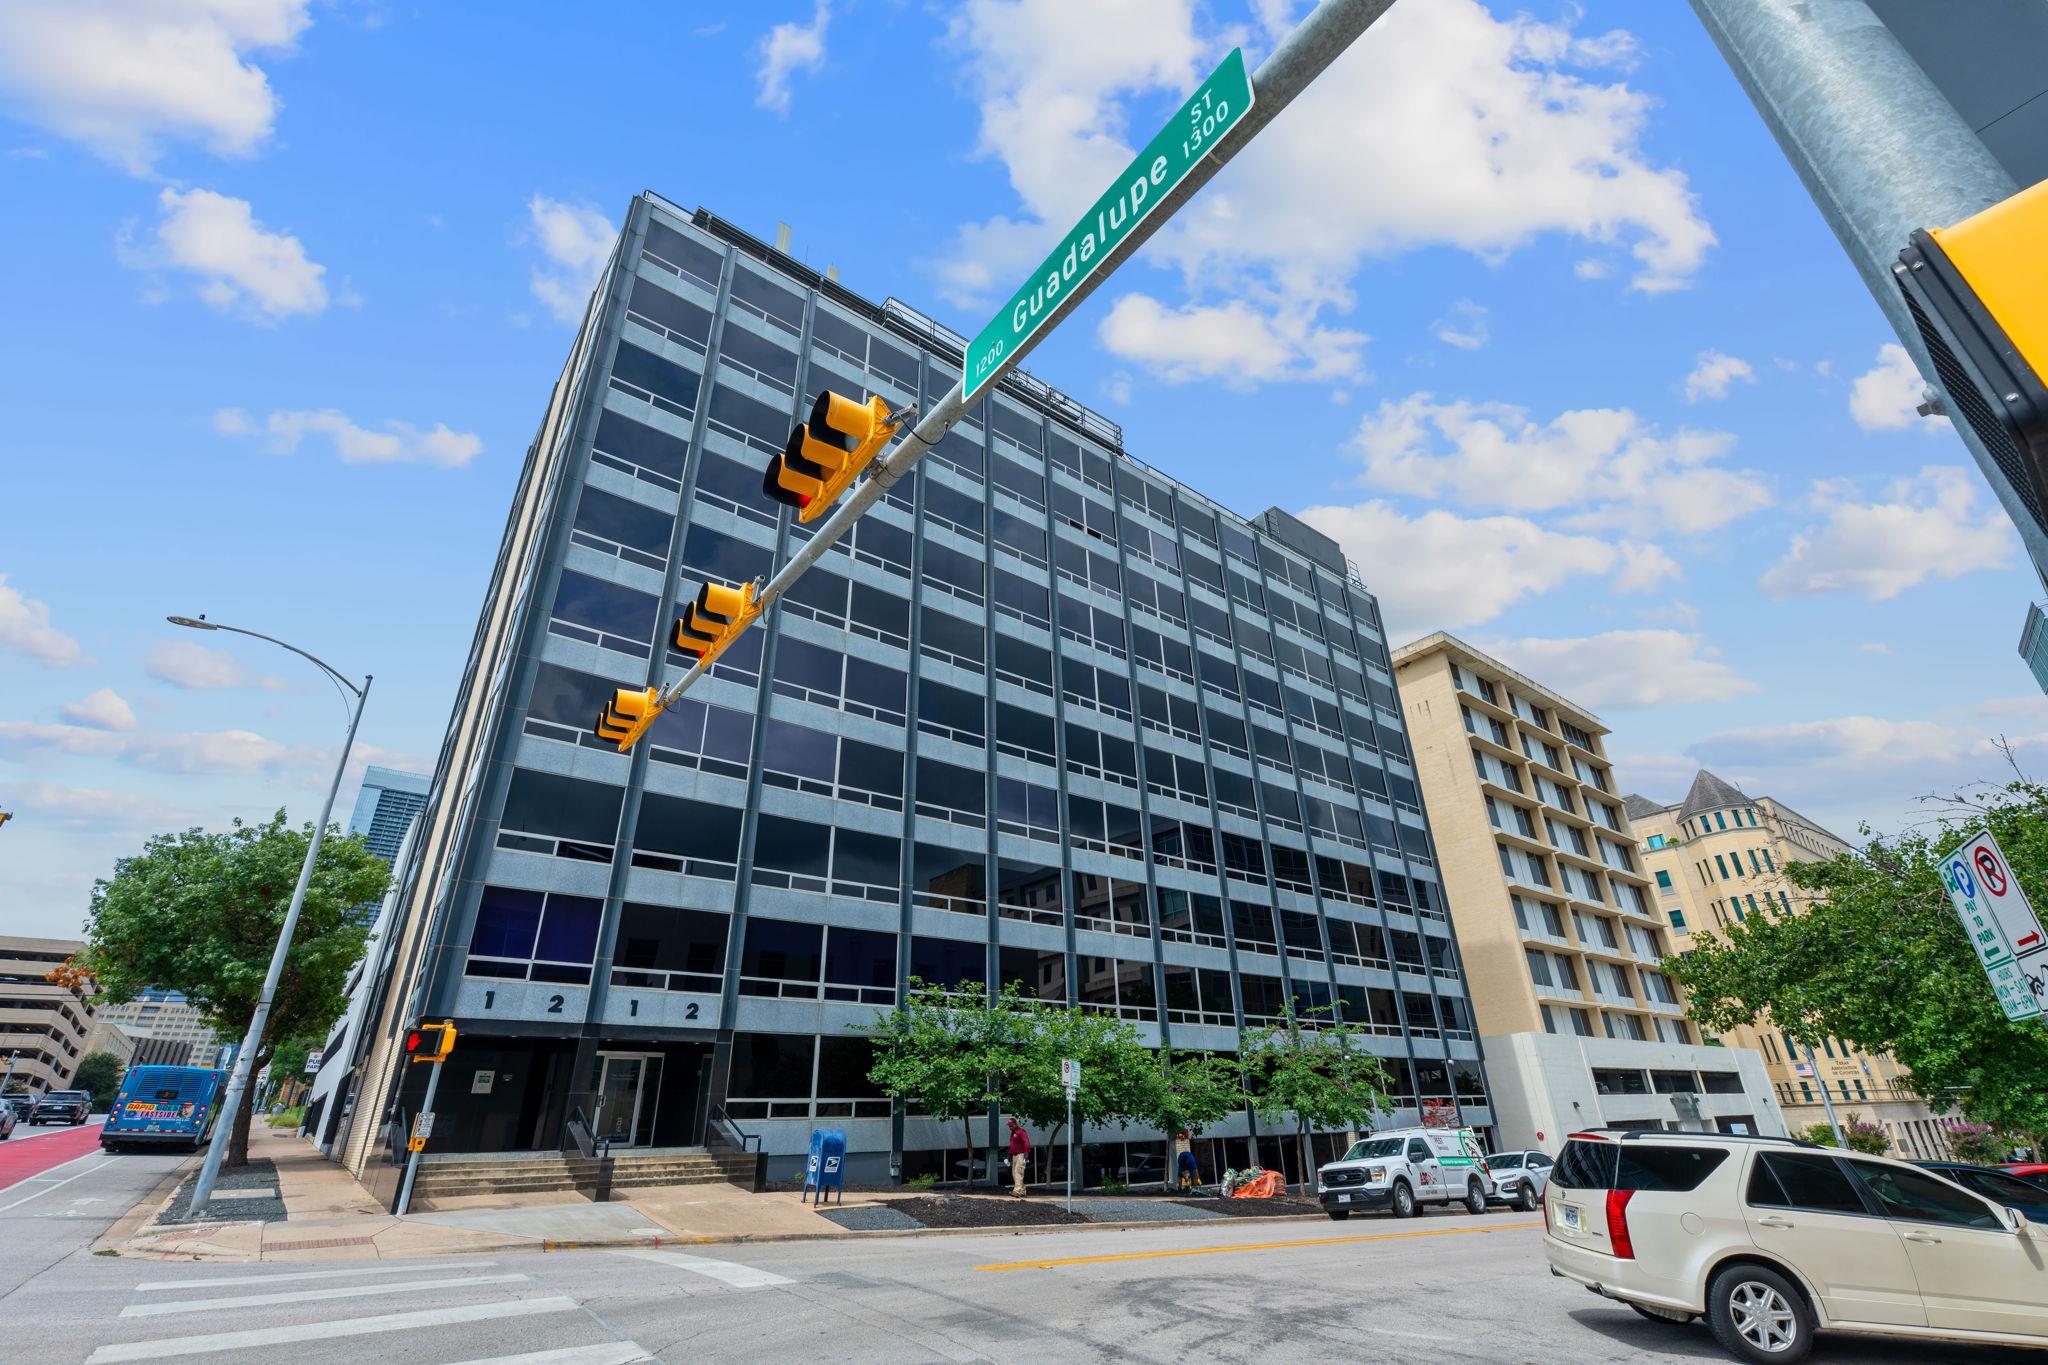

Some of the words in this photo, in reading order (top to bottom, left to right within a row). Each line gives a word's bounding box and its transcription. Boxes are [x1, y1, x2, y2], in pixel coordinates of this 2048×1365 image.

[1191, 88, 1213, 124] ST
[975, 339, 1004, 378] 1200
[1012, 153, 1168, 334] Guadalupe
[1182, 100, 1229, 160] 1300
[1965, 899, 1978, 915] PAY
[1973, 915, 1984, 928] TO
[1977, 928, 1996, 945] PARK
